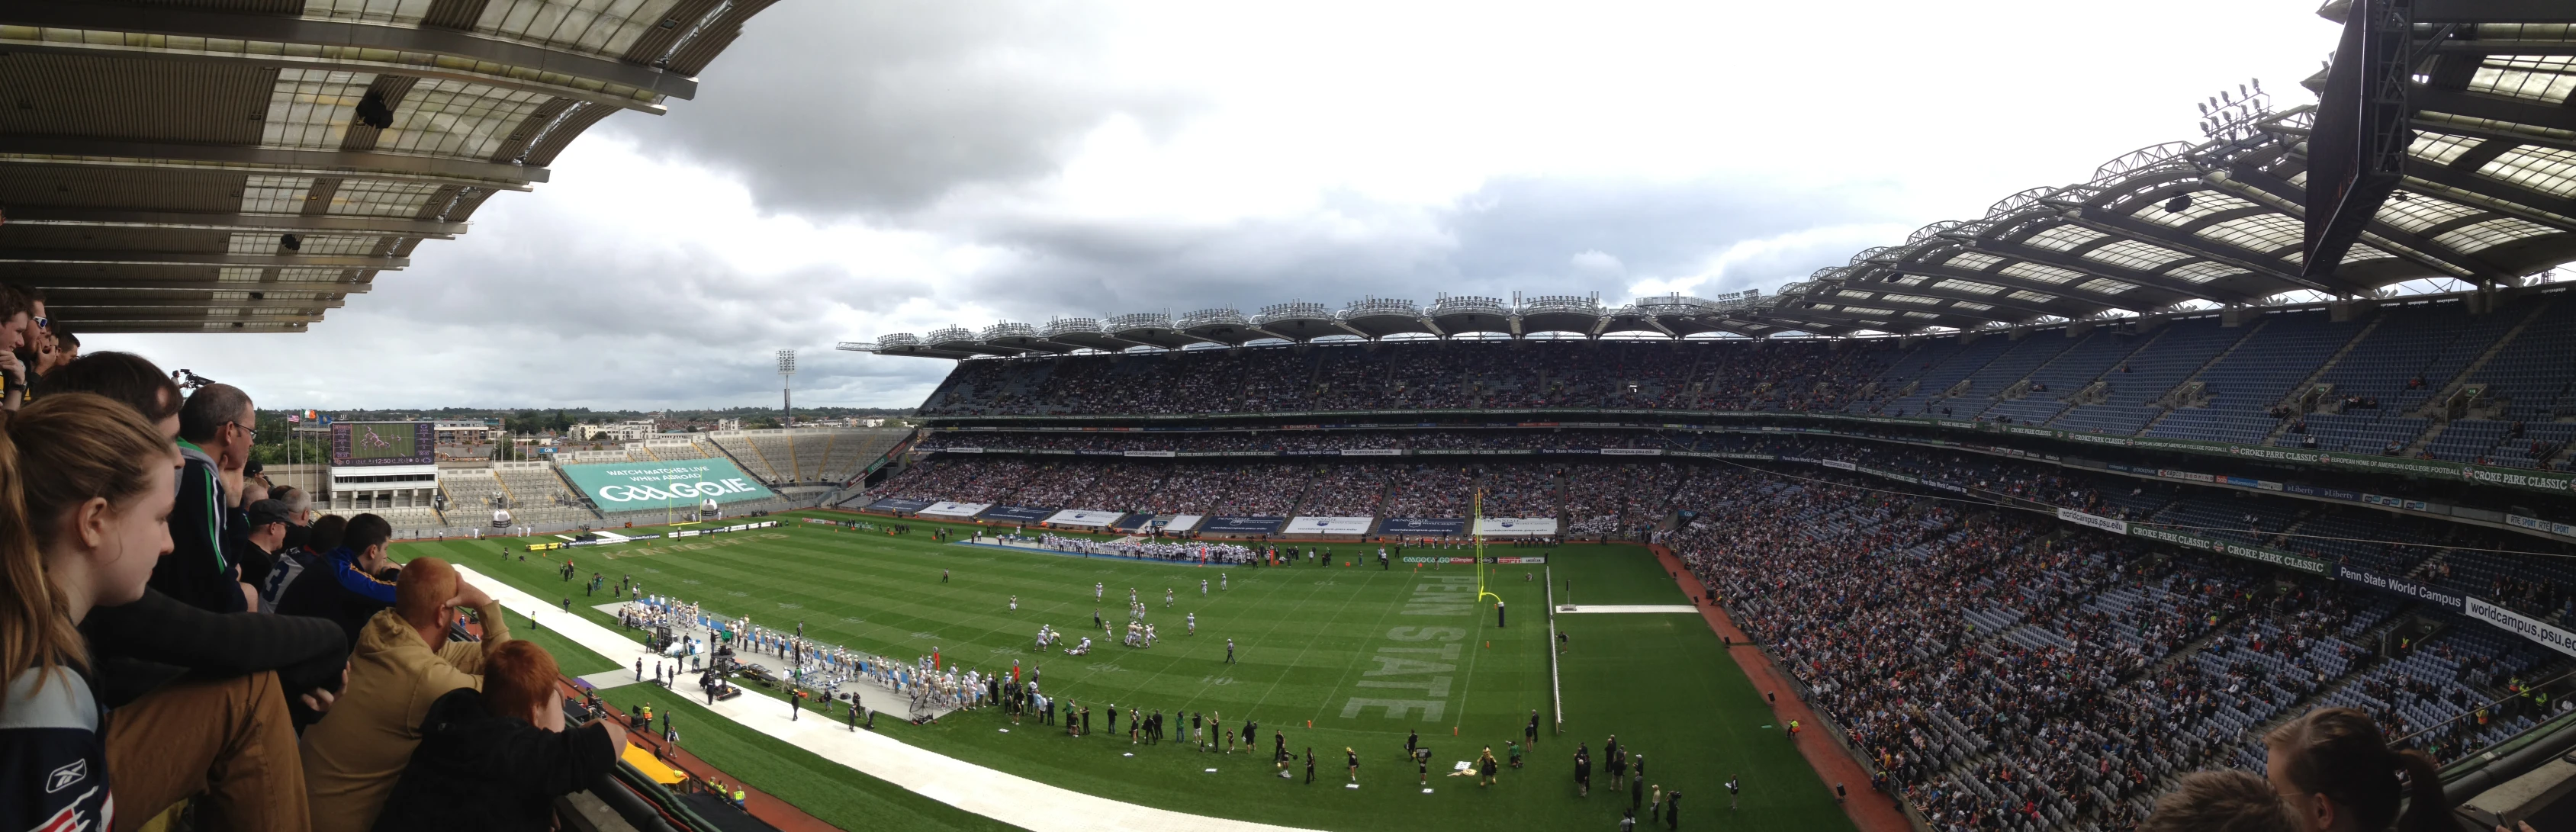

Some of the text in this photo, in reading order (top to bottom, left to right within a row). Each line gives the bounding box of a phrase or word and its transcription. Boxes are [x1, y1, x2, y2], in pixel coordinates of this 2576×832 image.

[2075, 434, 2125, 445] CROKE PARK CLASSIC
[2240, 448, 2317, 462] CROKE PARK CLASSIC
[2405, 464, 2430, 472] COLLEGE
[2431, 467, 2460, 476] FOOTBALL
[2474, 470, 2568, 490] CROKE PARK CLASSIC
[2291, 485, 2314, 495] Liberty
[2329, 490, 2354, 500] Liberty
[2062, 509, 2123, 532] worldcampus.psu.edu
[2522, 519, 2536, 528] SPORT
[2133, 527, 2210, 549] CROKE PARK CLASSIC
[2554, 525, 2570, 534] SPORT
[2227, 545, 2324, 573] CROKE PARK CLASSIC
[1400, 575, 1482, 615] PENN
[2340, 567, 2462, 608] Penn State World Campus
[1339, 626, 1466, 722] STATE
